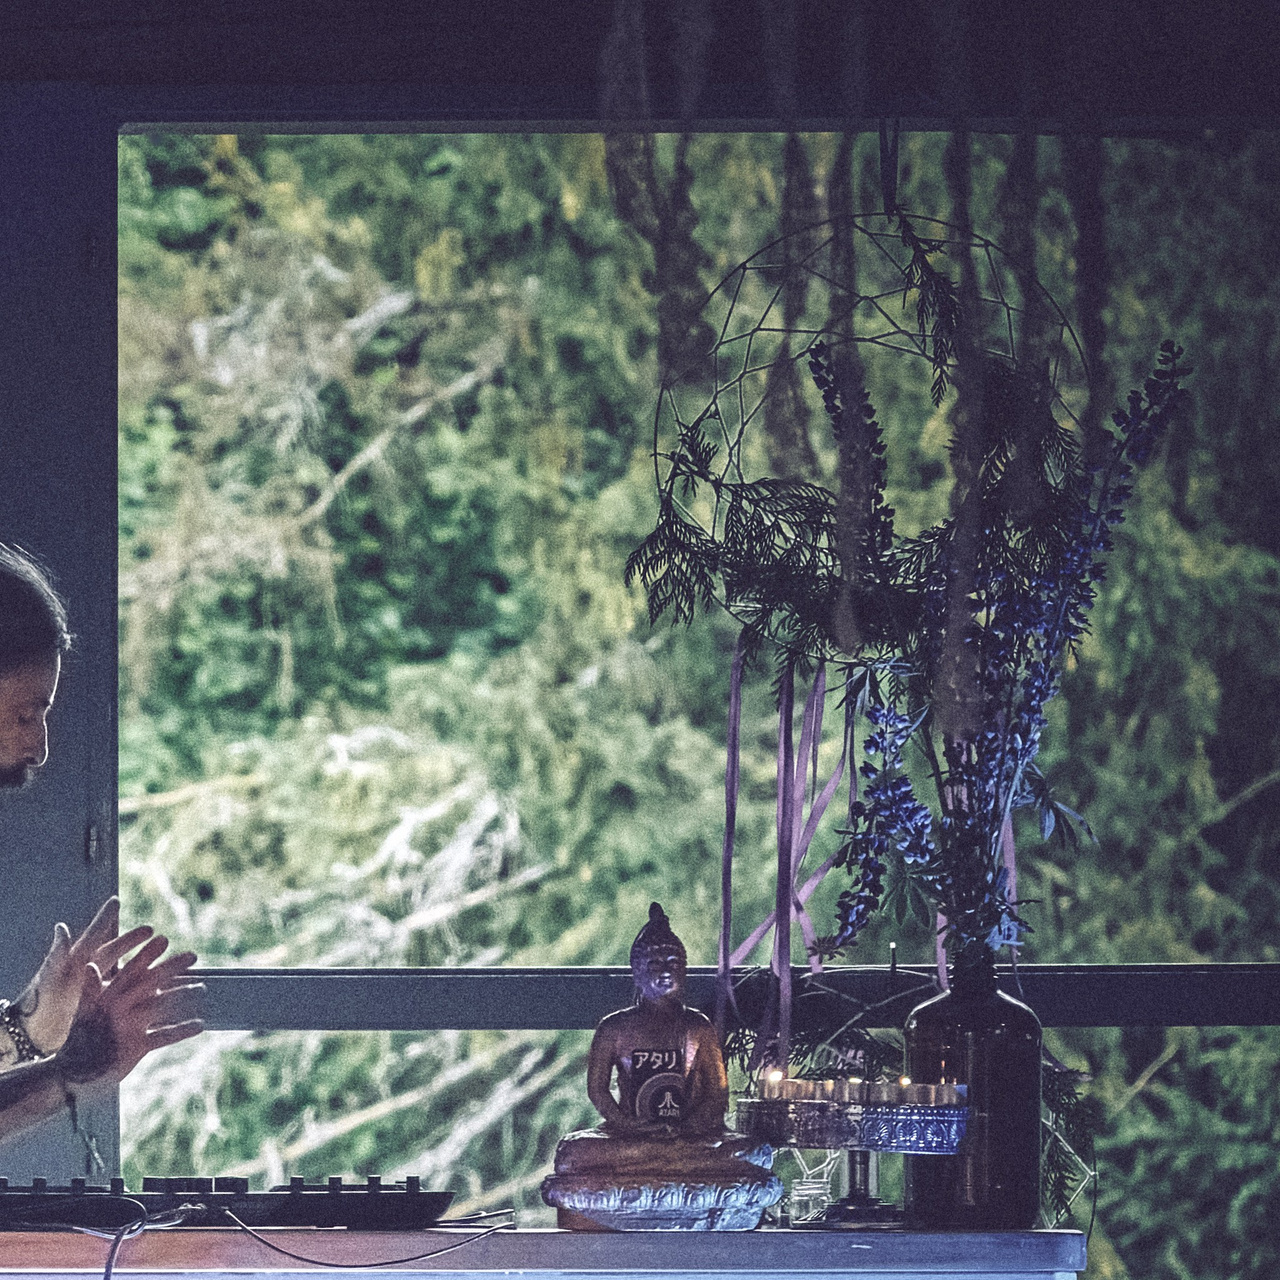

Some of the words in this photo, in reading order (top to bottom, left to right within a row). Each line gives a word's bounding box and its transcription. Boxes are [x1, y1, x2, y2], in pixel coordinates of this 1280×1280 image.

[633, 1051, 677, 1069] アタリ
[658, 1108, 680, 1117] ATARI
